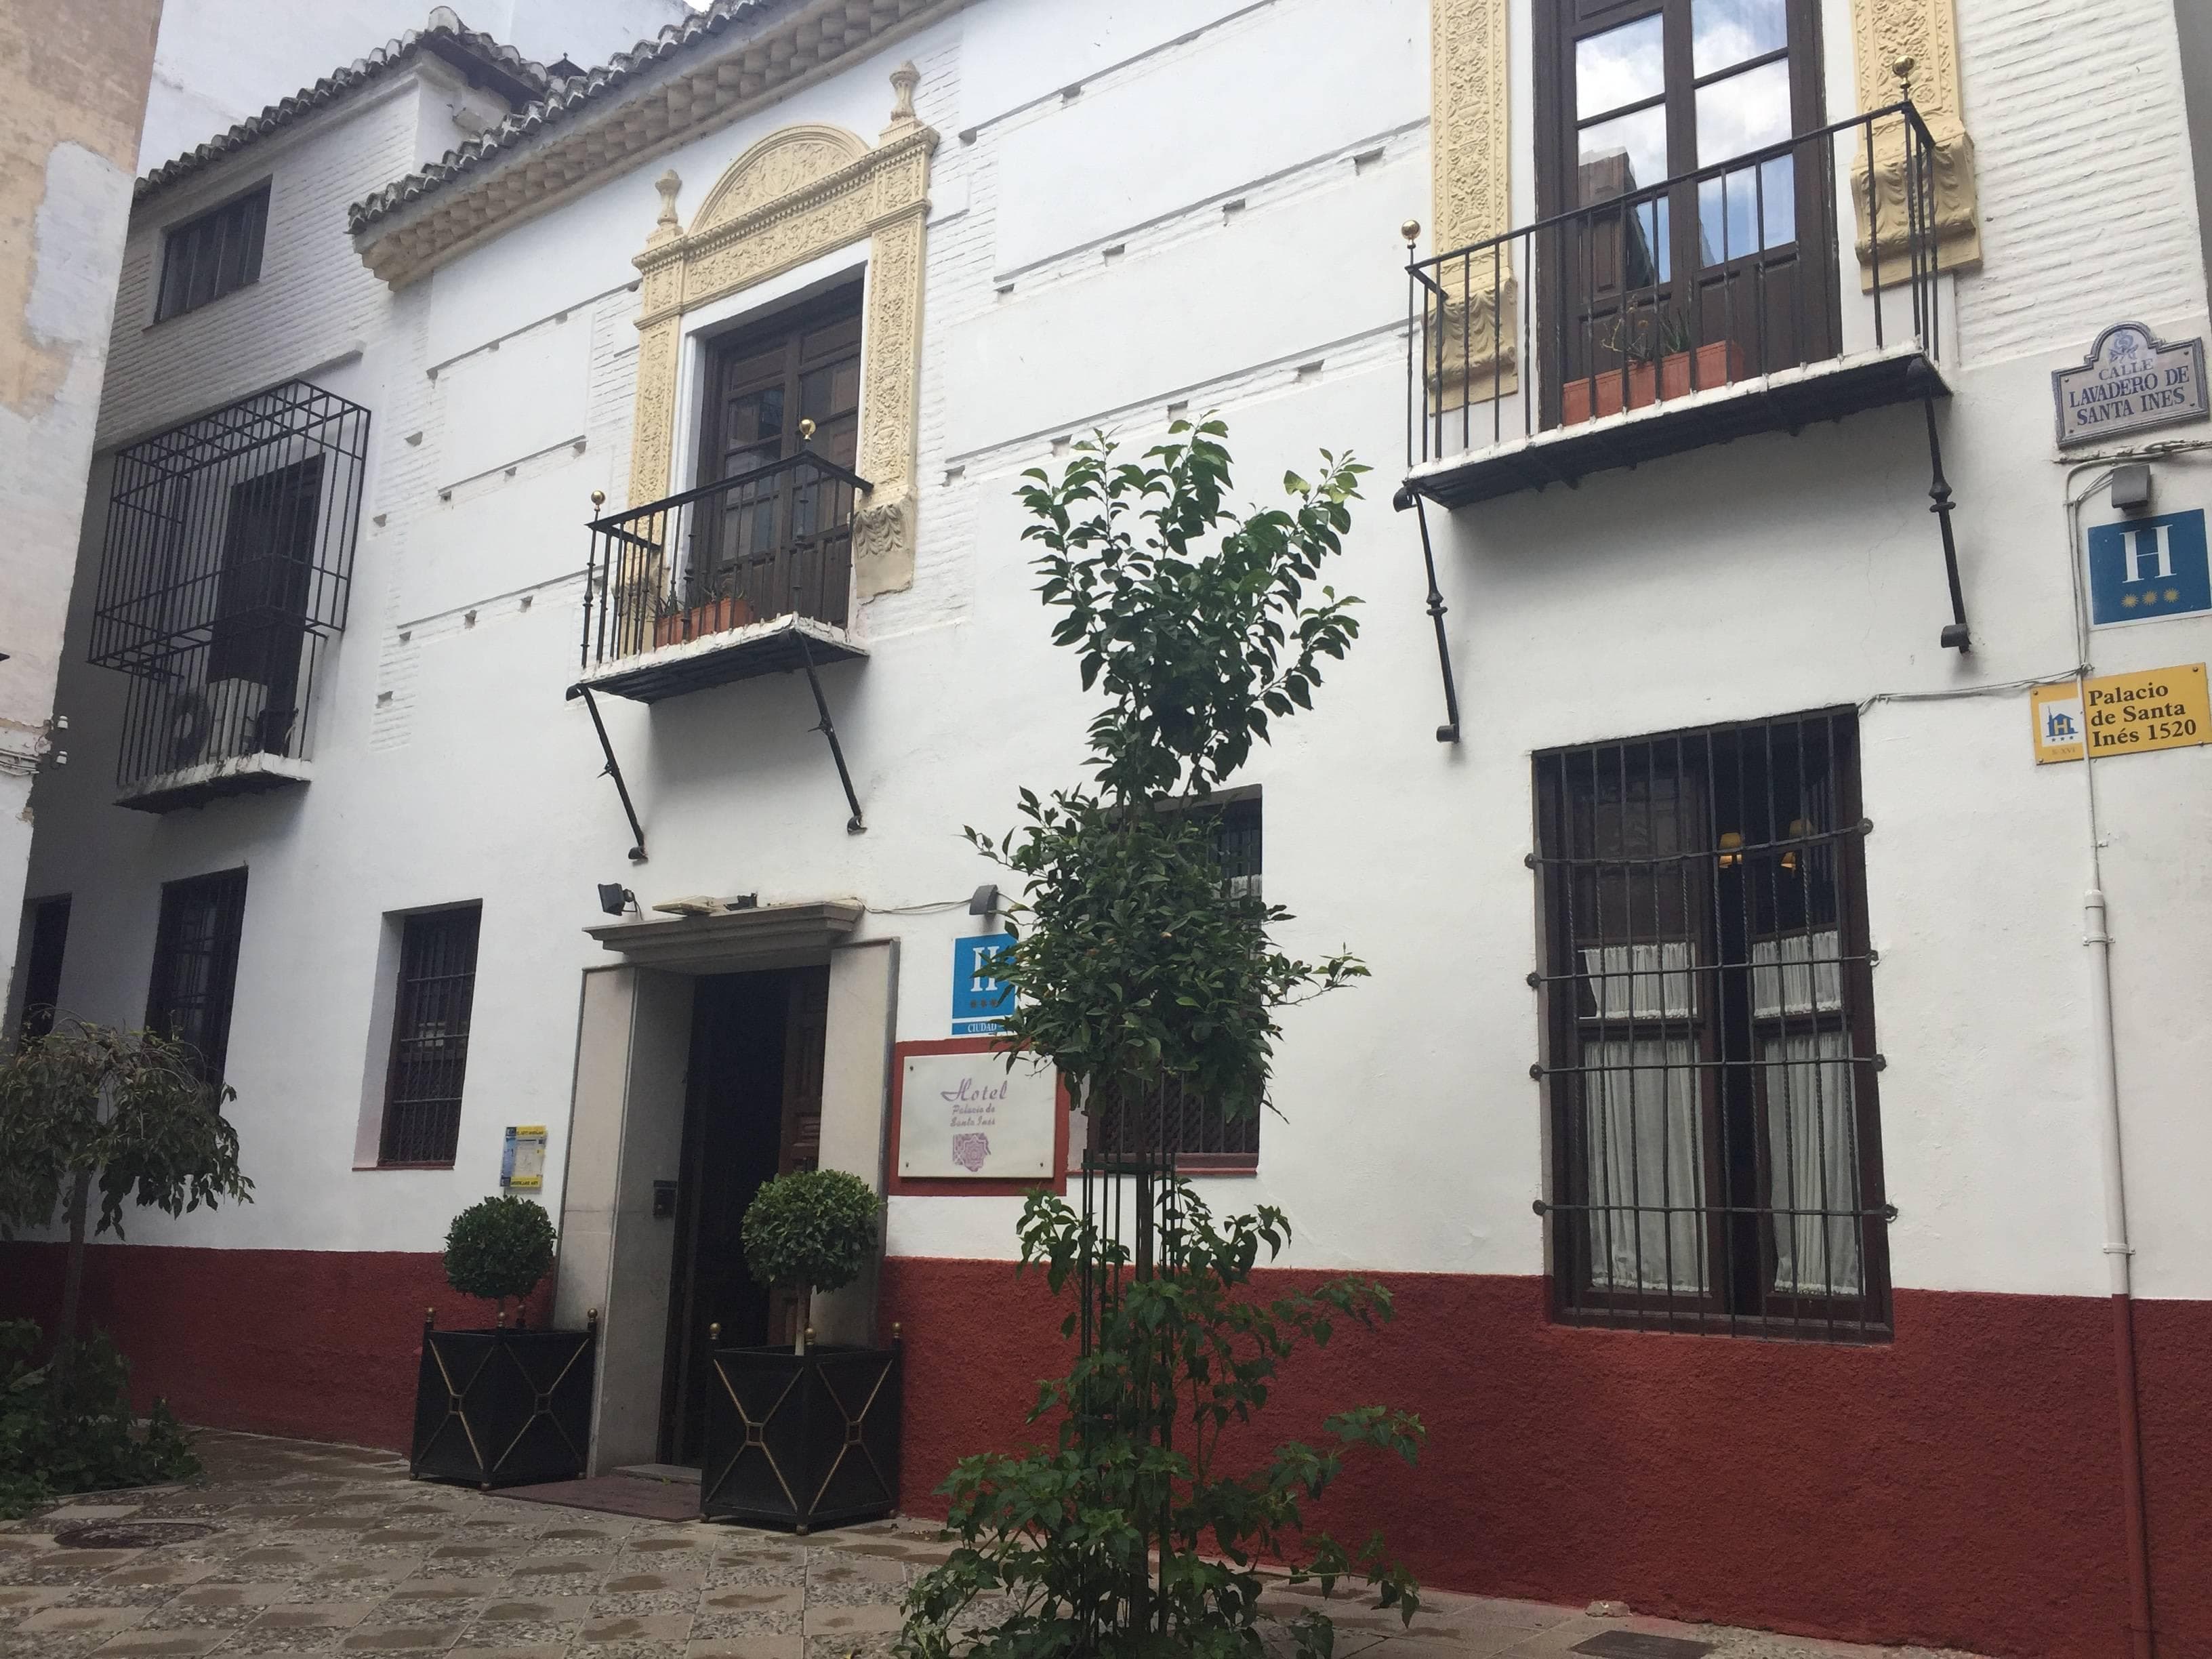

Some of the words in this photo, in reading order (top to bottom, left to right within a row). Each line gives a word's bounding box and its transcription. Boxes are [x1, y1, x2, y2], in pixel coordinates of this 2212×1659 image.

[2098, 358, 2154, 381] CALLE
[2069, 373, 2158, 408] LAVADERO
[2165, 365, 2190, 386] DE
[2076, 398, 2134, 426] SANTA
[2140, 386, 2186, 412] INES
[2119, 524, 2177, 583] H
[2088, 682, 2169, 707] Palacio
[2091, 710, 2116, 727] de
[2123, 702, 2186, 723] Santa
[2092, 727, 2140, 747] Inés
[2147, 718, 2197, 741] 1520
[967, 1023, 998, 1033] CIUDAD
[940, 1078, 1008, 1102] Hotel
[951, 1103, 984, 1115] Palacio
[985, 1102, 996, 1113] de
[949, 1116, 975, 1127] Santa
